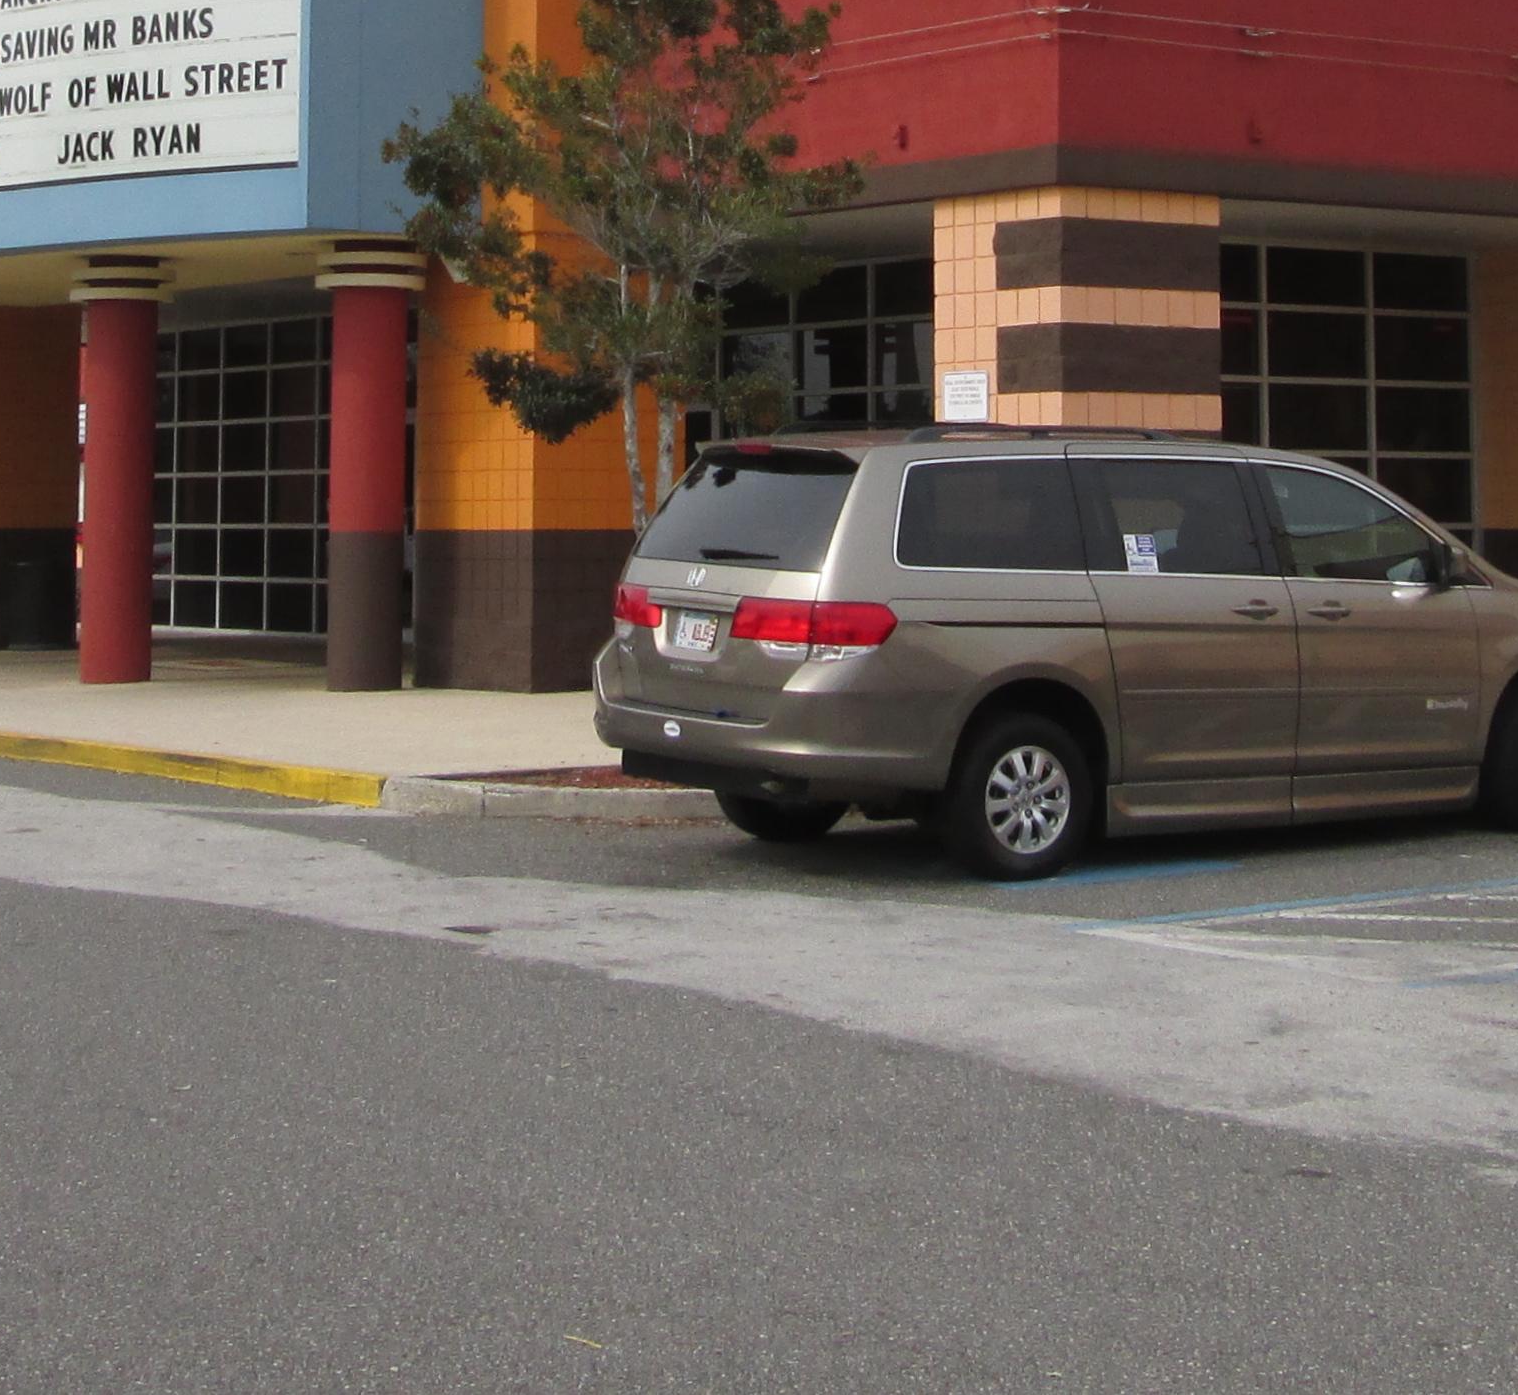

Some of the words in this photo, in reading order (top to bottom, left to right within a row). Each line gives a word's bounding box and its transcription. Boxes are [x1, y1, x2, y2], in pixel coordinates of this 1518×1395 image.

[0, 24, 75, 63] SAVING
[83, 19, 117, 51] MR
[131, 7, 214, 45] BANKS
[68, 76, 97, 108] OF
[107, 68, 171, 104] WALL
[184, 58, 289, 98] STREET
[57, 130, 115, 165] JACK
[132, 122, 201, 158] RYAN
